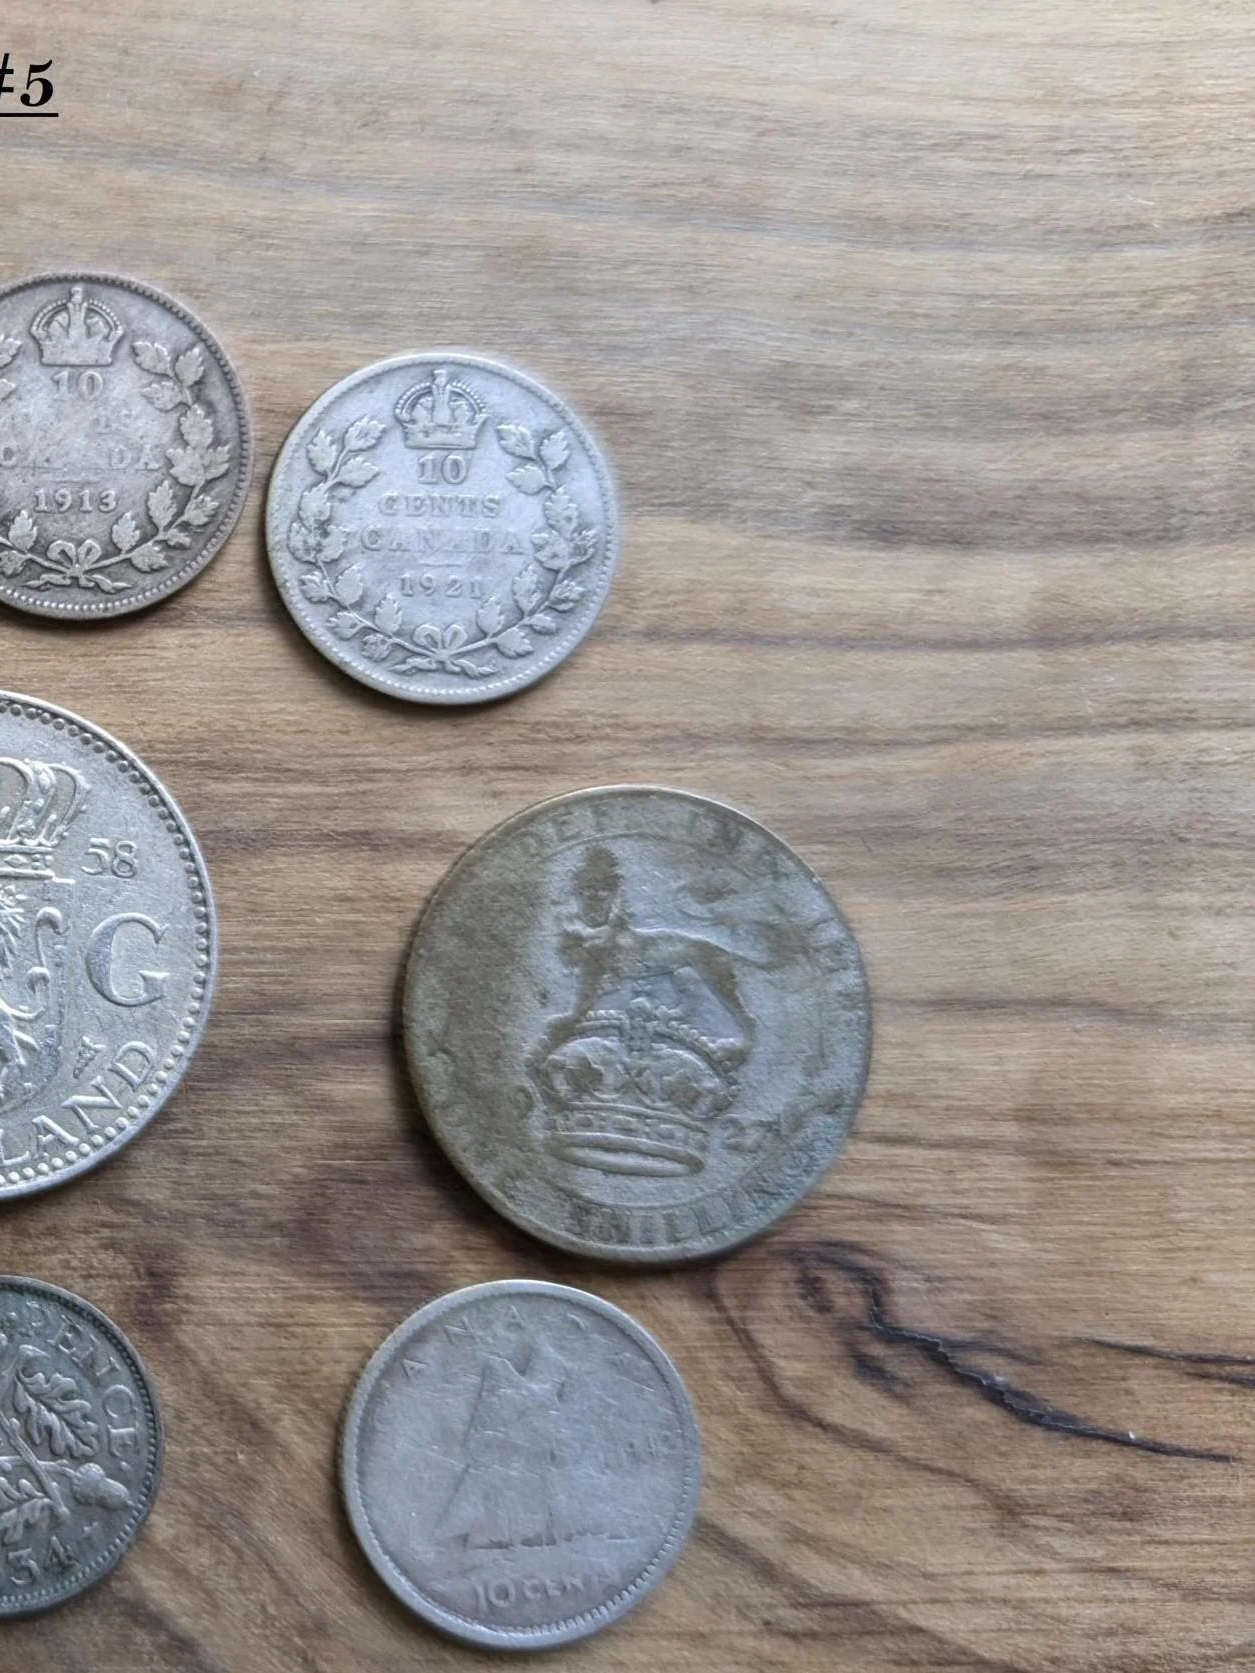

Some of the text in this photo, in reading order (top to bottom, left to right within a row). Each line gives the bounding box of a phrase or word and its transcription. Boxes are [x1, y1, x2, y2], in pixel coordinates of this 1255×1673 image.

[51, 370, 104, 401] 10
[417, 454, 468, 485] 10
[34, 488, 118, 513] 1913
[378, 492, 502, 518] CENTS
[399, 573, 484, 599] 1921
[80, 837, 140, 880] 58
[84, 912, 170, 1007] G
[470, 1575, 517, 1612] 10
